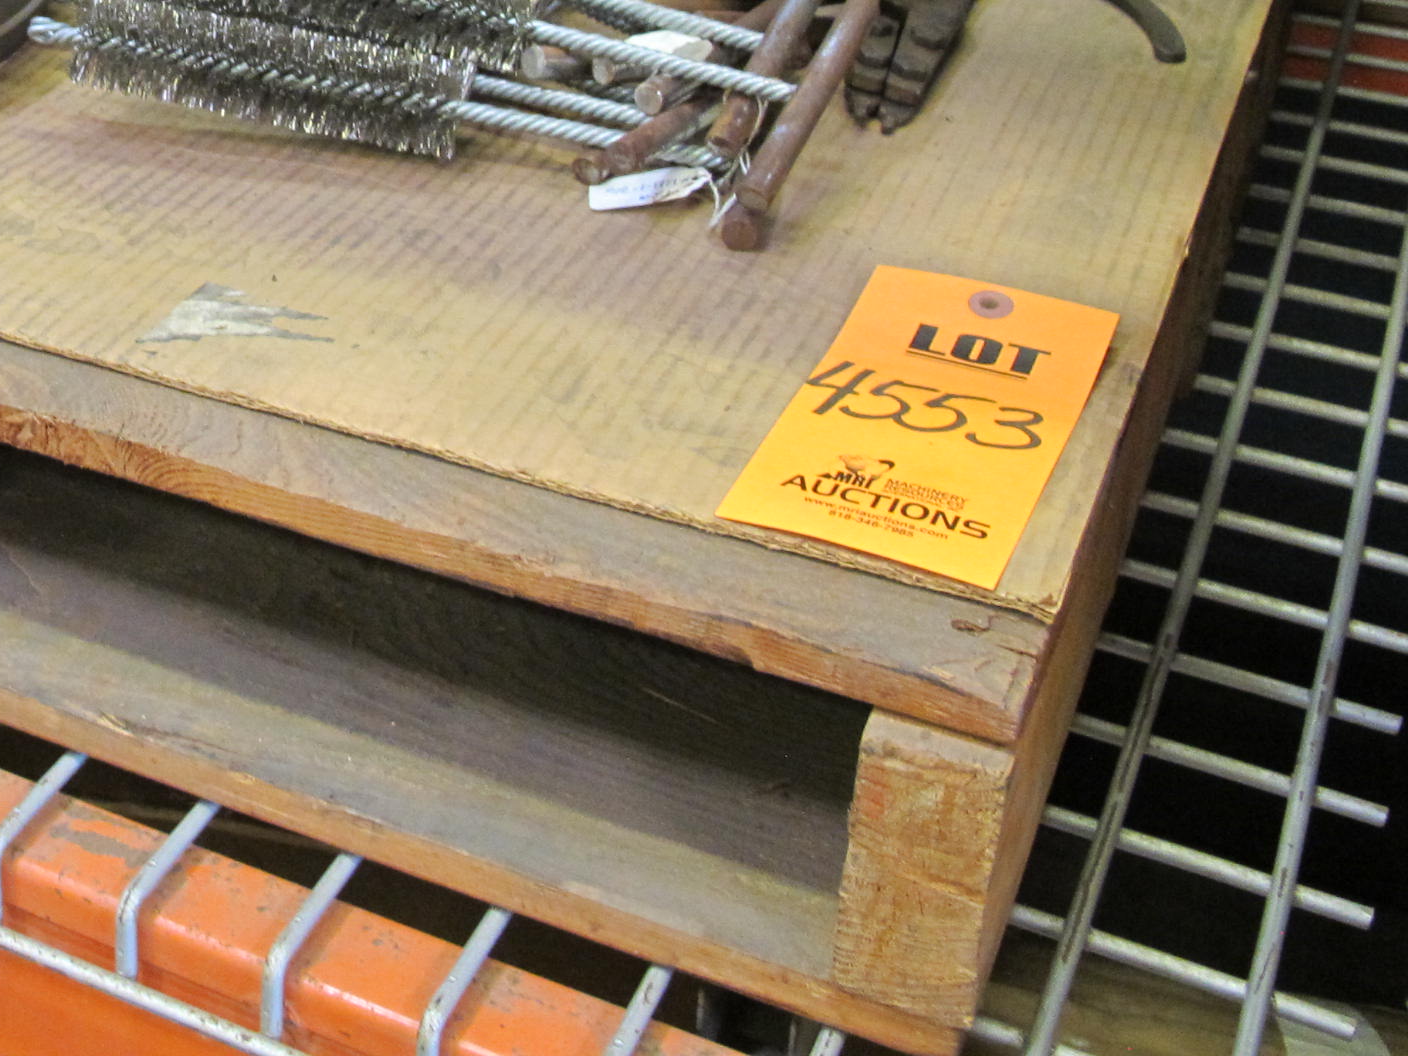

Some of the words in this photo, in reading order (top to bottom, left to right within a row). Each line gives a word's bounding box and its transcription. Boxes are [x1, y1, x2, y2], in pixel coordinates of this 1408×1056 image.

[908, 323, 1052, 375] LOT
[806, 360, 1044, 450] 4553
[780, 474, 992, 540] AUCTIONS
[886, 478, 968, 504] MACHINERY
